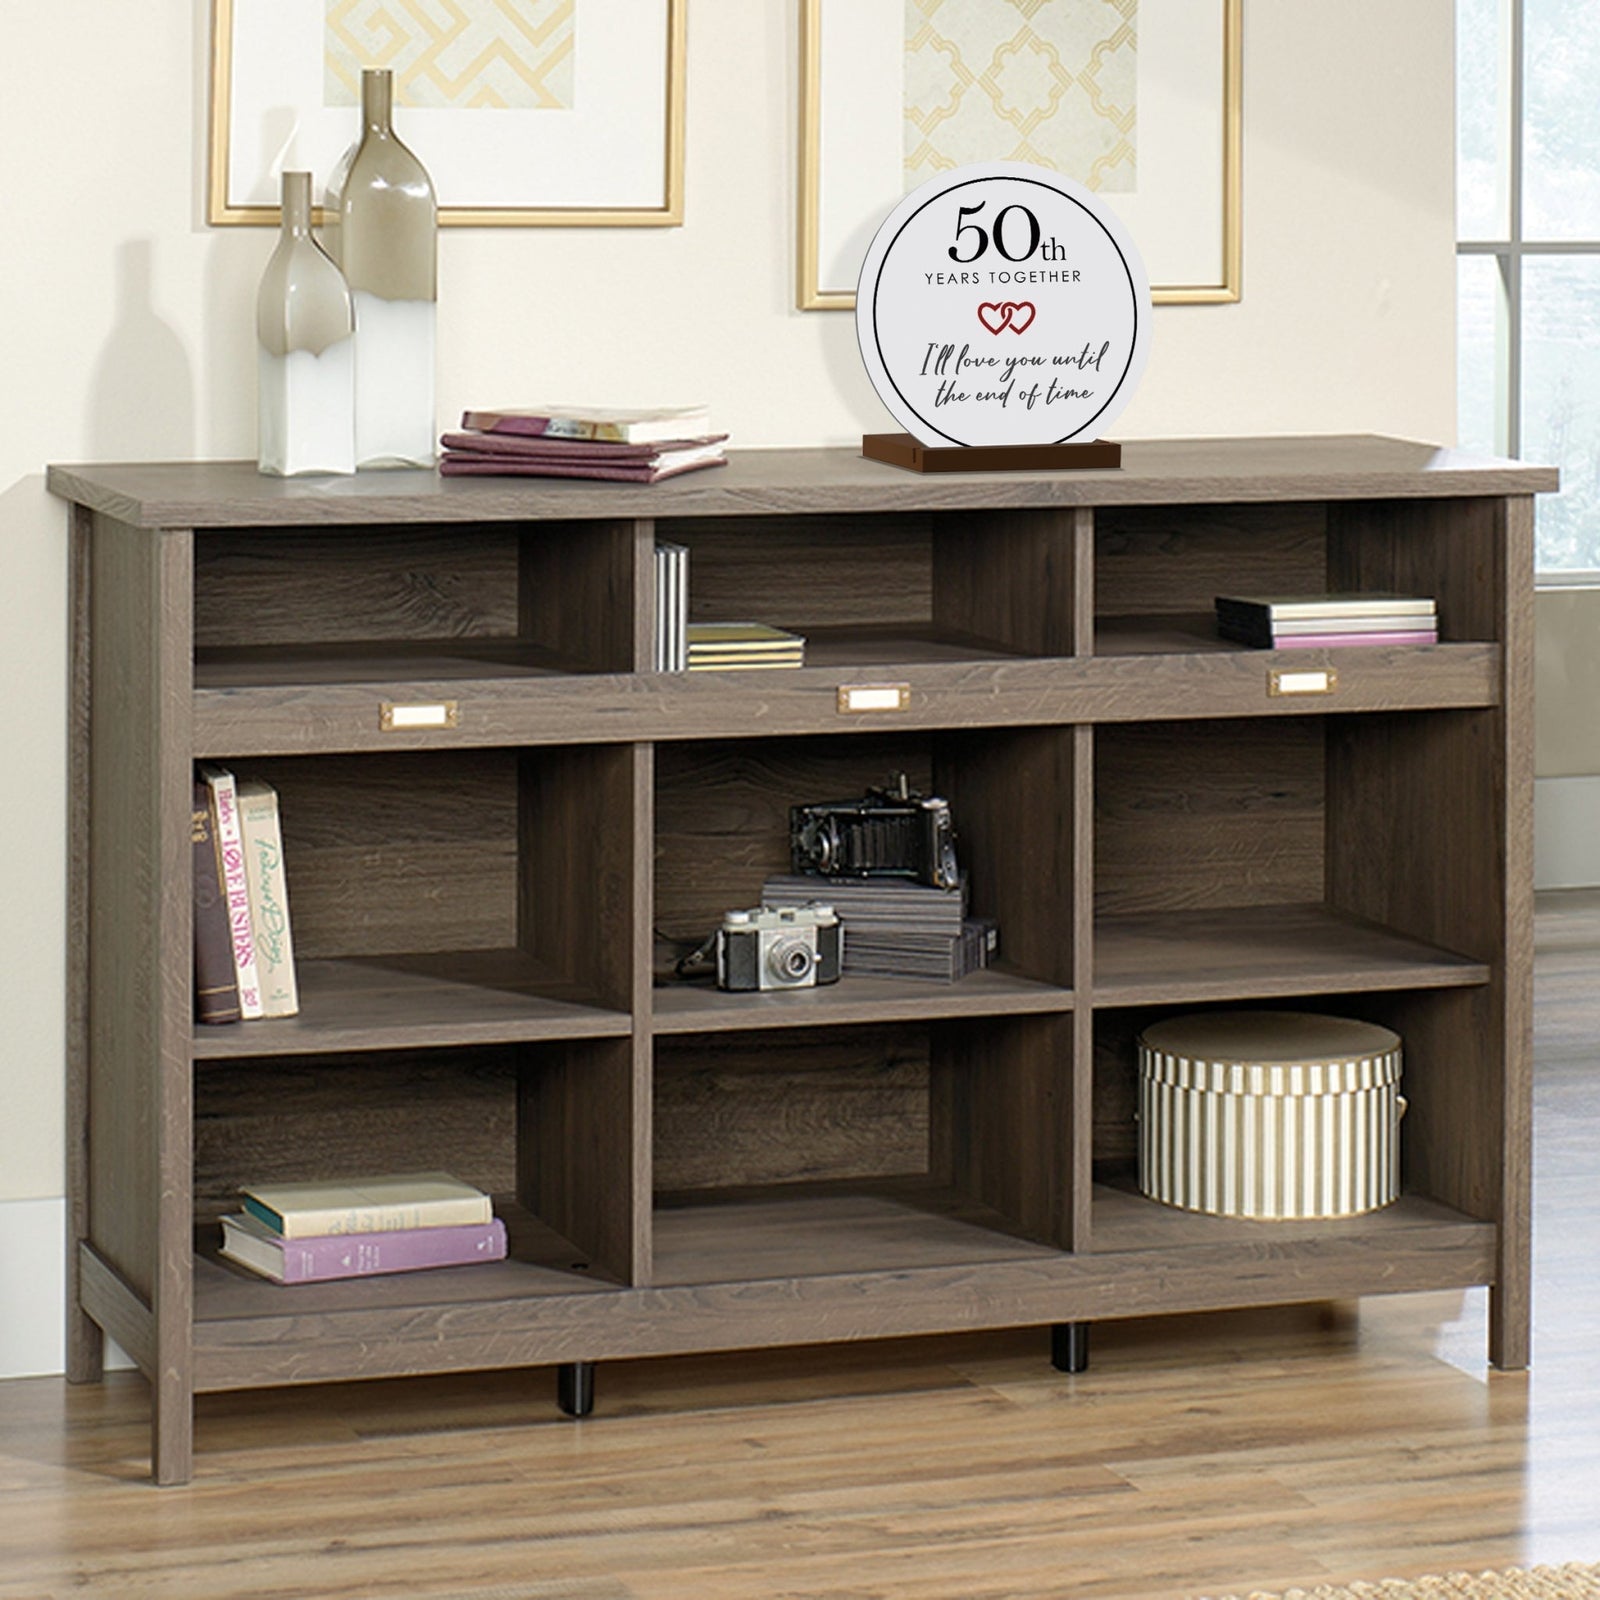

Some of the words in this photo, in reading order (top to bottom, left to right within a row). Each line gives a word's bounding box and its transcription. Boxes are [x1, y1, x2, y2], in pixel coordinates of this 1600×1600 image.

[948, 200, 1067, 264] 50th
[924, 272, 981, 285] YEARS
[989, 270, 1082, 284] TOGETHER
[919, 342, 953, 376] I'll
[955, 343, 1001, 376] love
[999, 356, 1046, 383] you
[1052, 340, 1110, 373] until
[934, 379, 971, 408] the
[975, 378, 1016, 409] end
[1019, 383, 1042, 411] of
[1045, 377, 1094, 406] time
